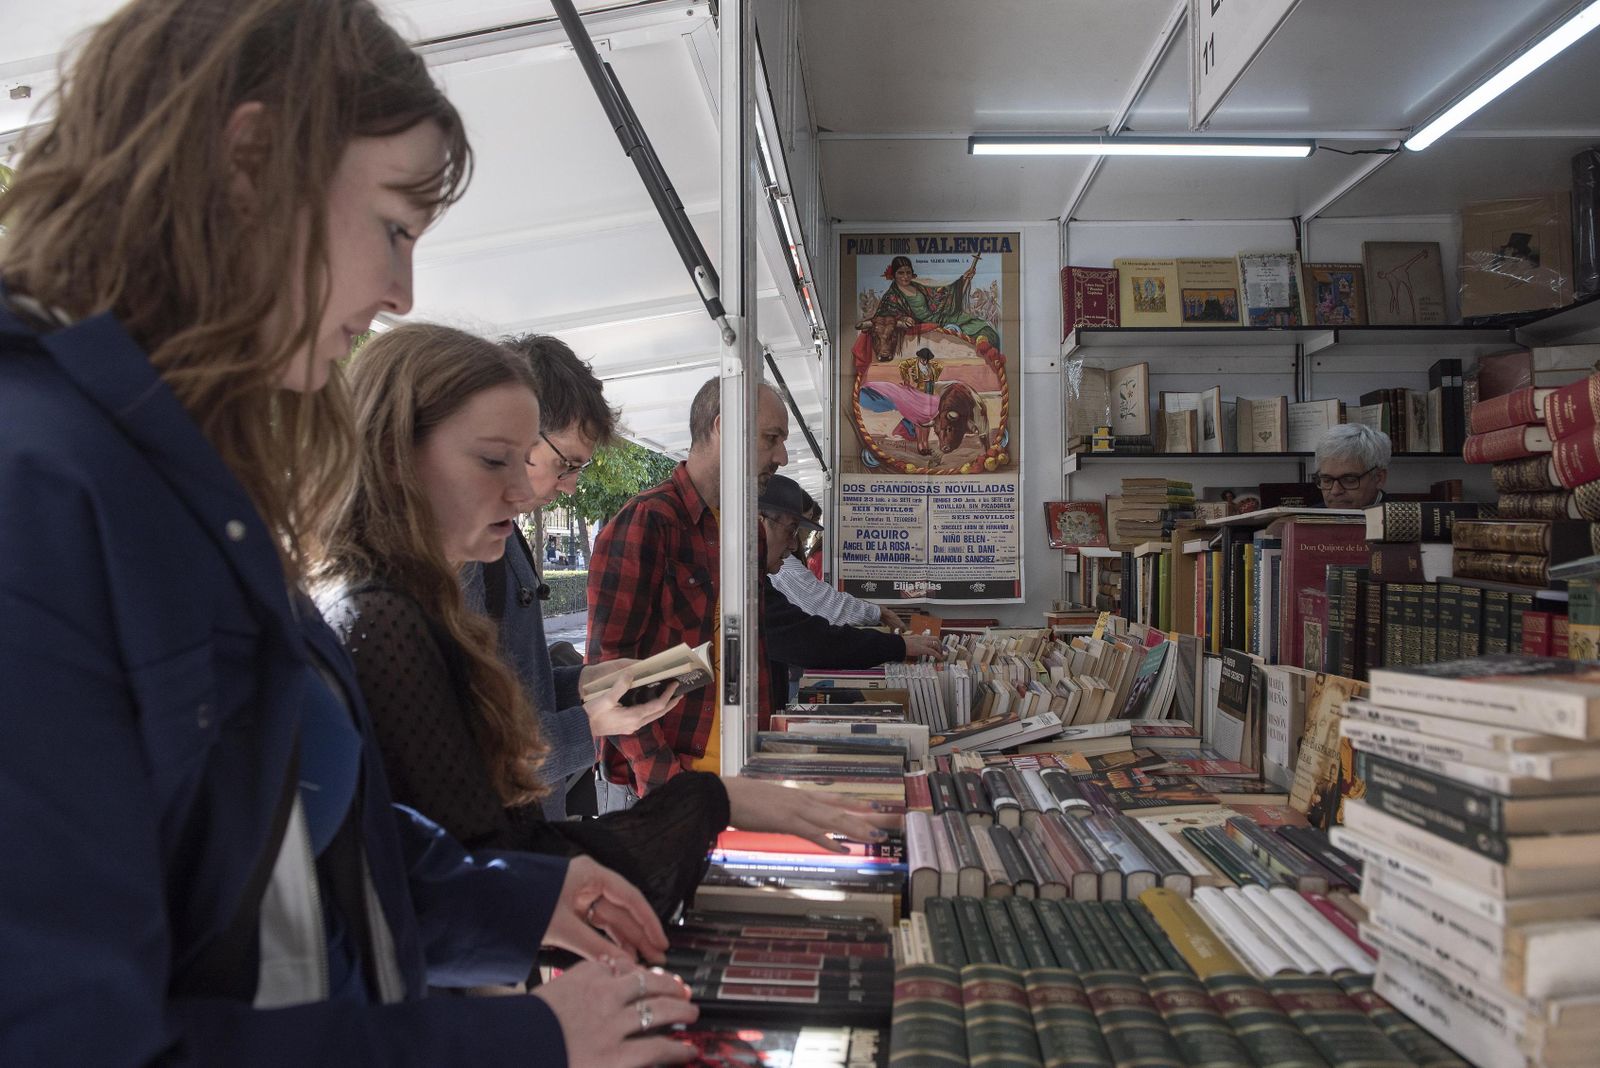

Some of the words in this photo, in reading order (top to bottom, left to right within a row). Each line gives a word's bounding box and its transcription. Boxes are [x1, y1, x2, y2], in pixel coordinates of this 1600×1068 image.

[1203, 32, 1214, 75] 11
[847, 238, 874, 254] PLAZA
[877, 238, 886, 254] DE
[889, 238, 911, 254] TOROS
[915, 237, 1012, 253] VALENCIA
[843, 484, 866, 492] DOS
[870, 484, 940, 493] GRANDIOSAS
[945, 484, 1015, 493] NOVILLADAS
[856, 529, 910, 540] PAQUIRO
[942, 534, 960, 543] NIÑO
[964, 535, 986, 543] BELEN
[866, 542, 875, 550] DE
[878, 542, 888, 550] LA
[890, 542, 910, 551] ROSA
[967, 545, 974, 554] EL
[978, 545, 995, 554] DANI
[1318, 544, 1344, 552] Quijote
[1346, 544, 1355, 552] de
[1356, 544, 1363, 552] la
[842, 552, 870, 562] MANUEL
[874, 553, 910, 562] AMADOR
[894, 582, 914, 592] Elija
